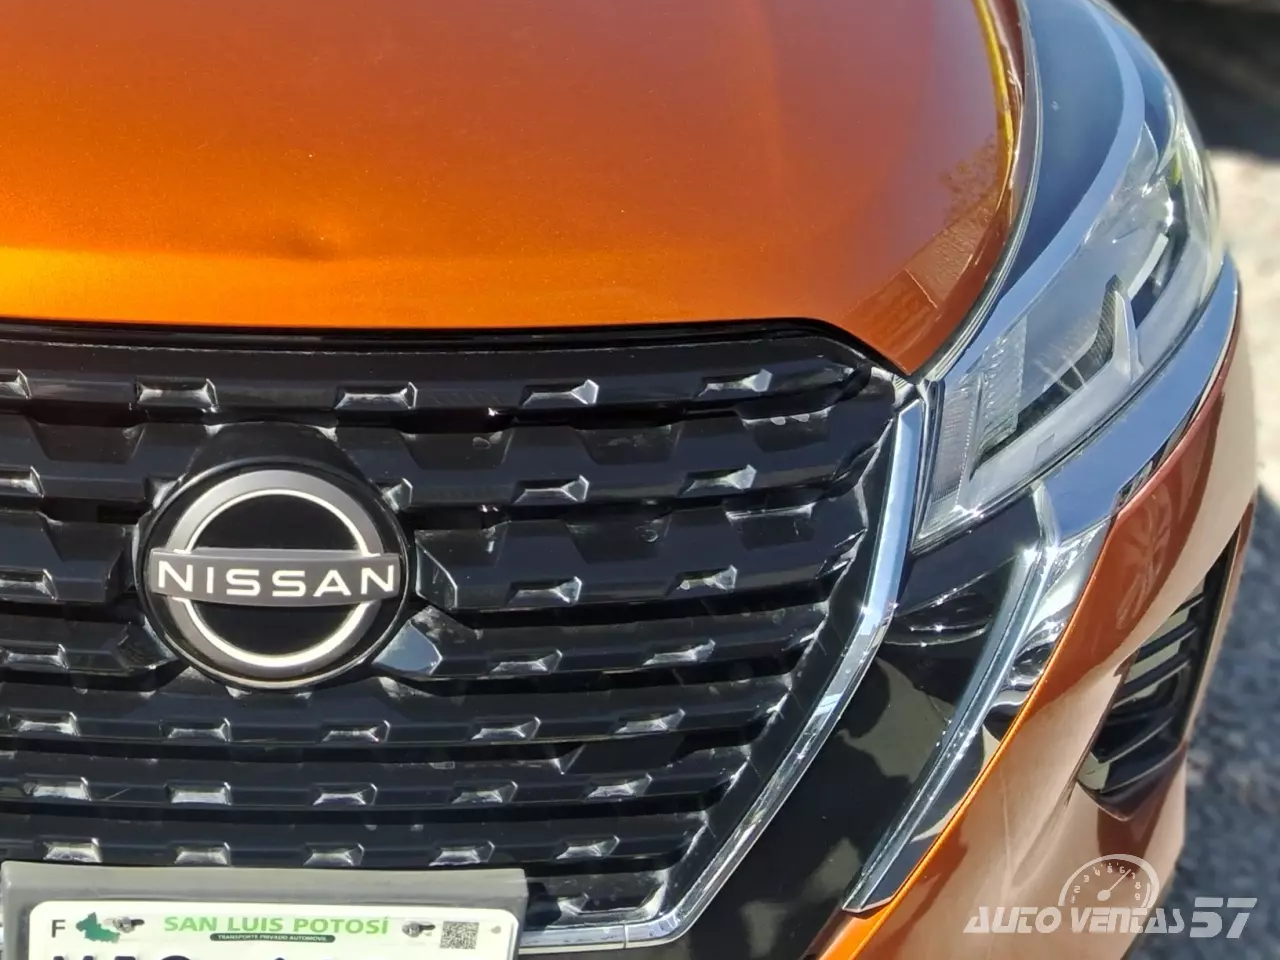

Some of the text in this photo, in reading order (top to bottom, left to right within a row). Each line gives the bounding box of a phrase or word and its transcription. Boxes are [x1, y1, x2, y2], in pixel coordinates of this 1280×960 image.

[158, 560, 395, 597] NISSAN
[51, 919, 66, 938] F
[164, 916, 389, 935] SAN LUIS POTOSÍ
